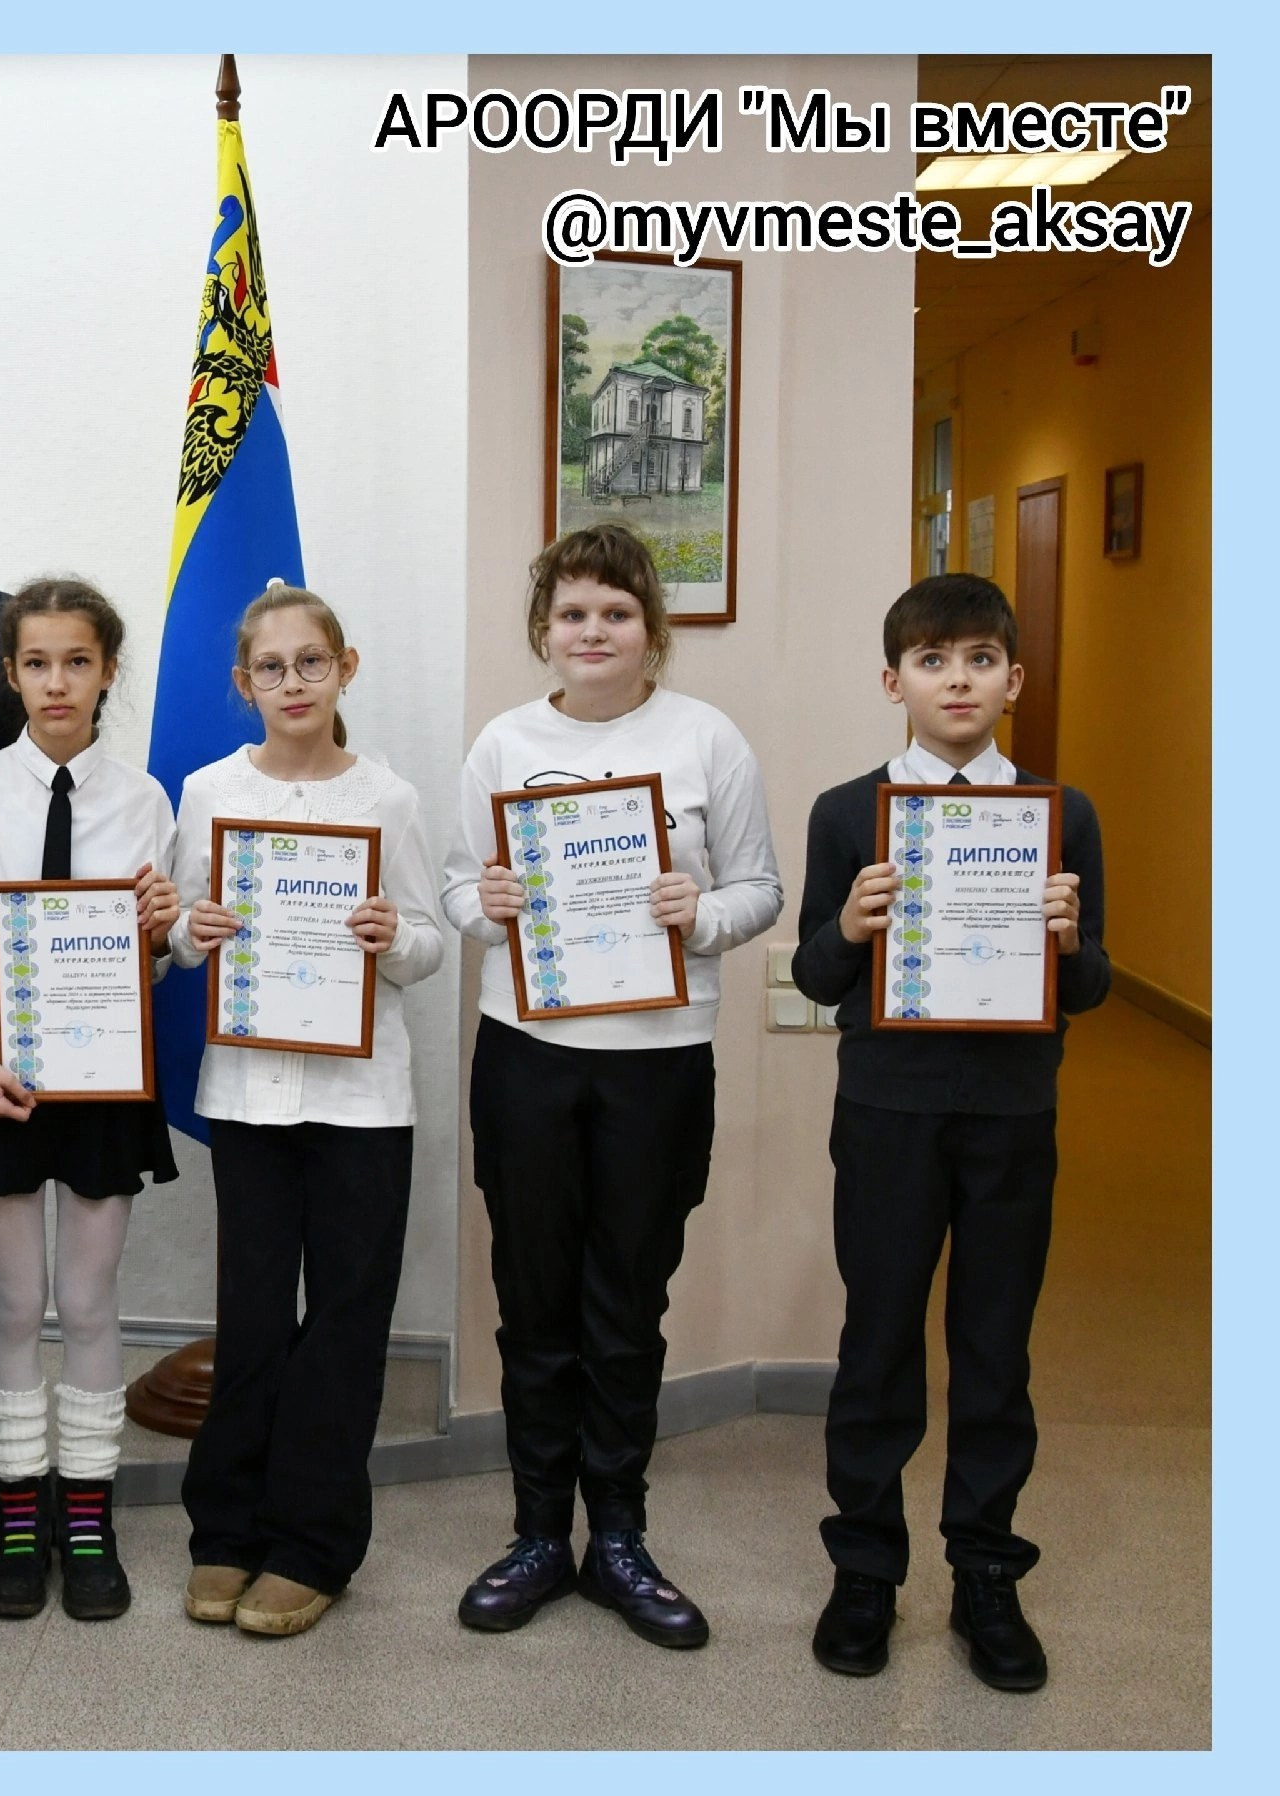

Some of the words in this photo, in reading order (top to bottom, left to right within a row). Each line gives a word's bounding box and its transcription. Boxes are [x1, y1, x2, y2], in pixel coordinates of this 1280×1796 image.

[564, 833, 647, 860] ДИПЛОМ
[571, 856, 646, 869] НАГРАЖДАЕТСЯ
[947, 847, 1038, 866] ДИПЛОМ
[953, 870, 1036, 878] НАГРАЖДАЕТСЯ
[275, 879, 358, 898] ДИПЛОМ
[280, 900, 355, 910] НАГРАЖДАЕТСЯ
[50, 936, 130, 954] ДИПЛОМ
